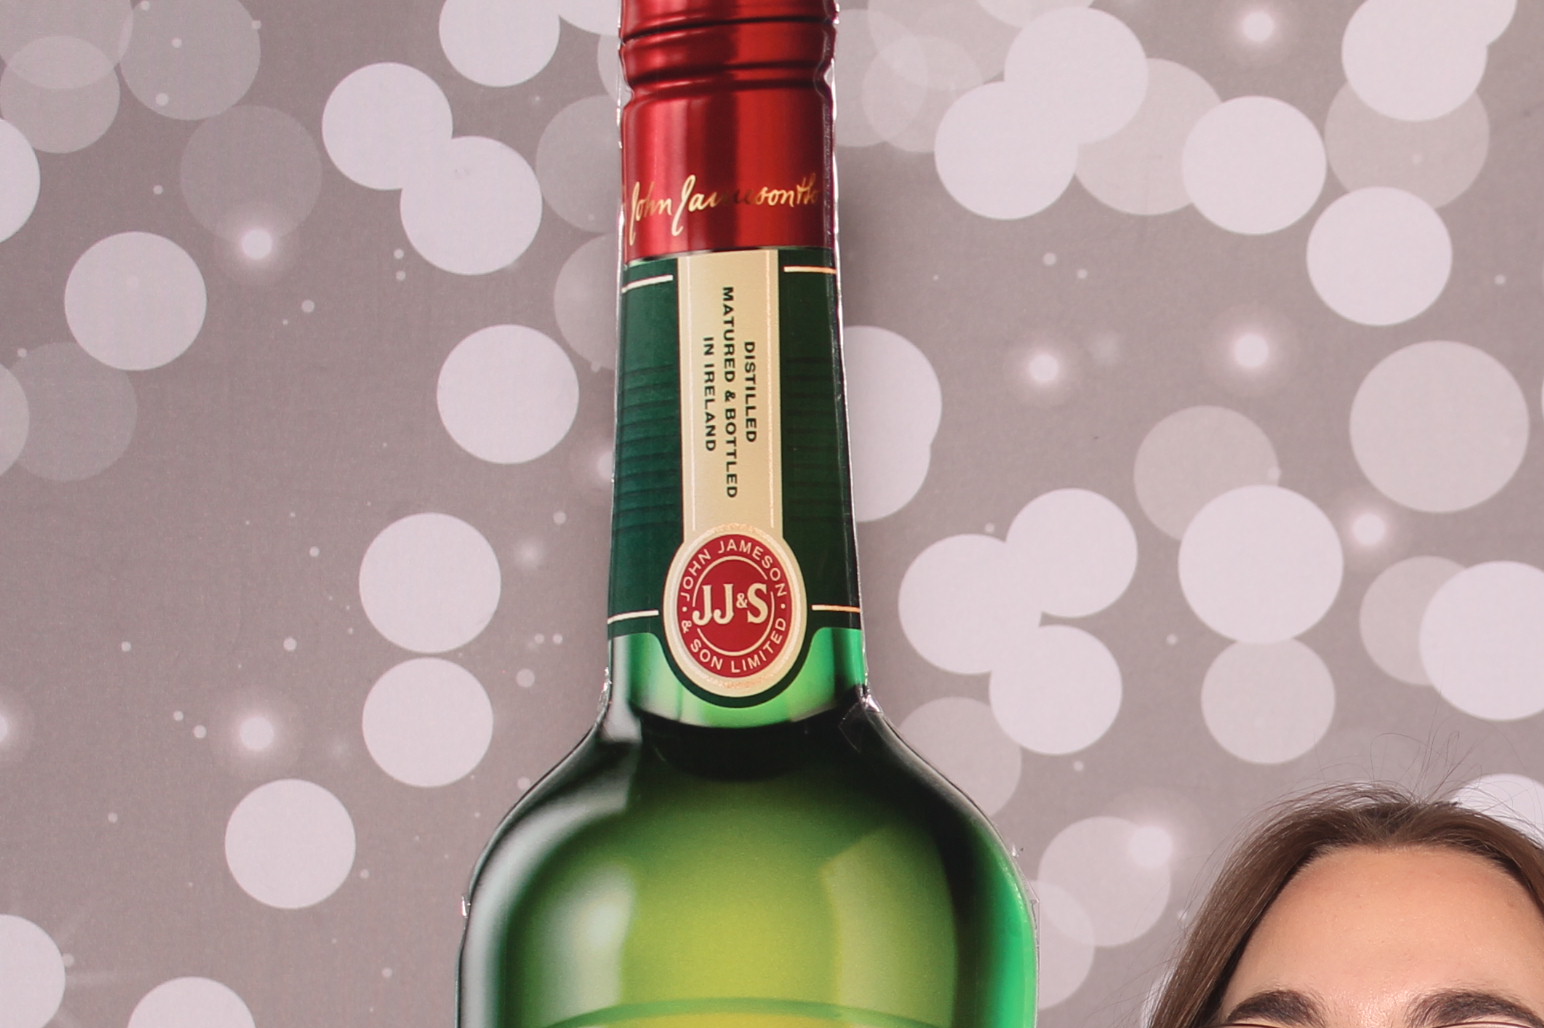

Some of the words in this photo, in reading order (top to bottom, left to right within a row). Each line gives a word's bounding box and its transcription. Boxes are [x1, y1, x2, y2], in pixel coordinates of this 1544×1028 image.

[629, 180, 673, 246] John
[703, 336, 715, 356] IN
[722, 286, 736, 383] MATURED
[704, 363, 717, 452] IRELAND
[724, 390, 736, 402] &
[743, 341, 757, 443] DISTILLED
[724, 408, 738, 499] BOTTLED
[680, 548, 712, 602] JOHN
[717, 538, 788, 597] JAMESON
[691, 582, 769, 626] JJ&S
[690, 638, 723, 671] SON
[730, 618, 787, 673] LIMITED
